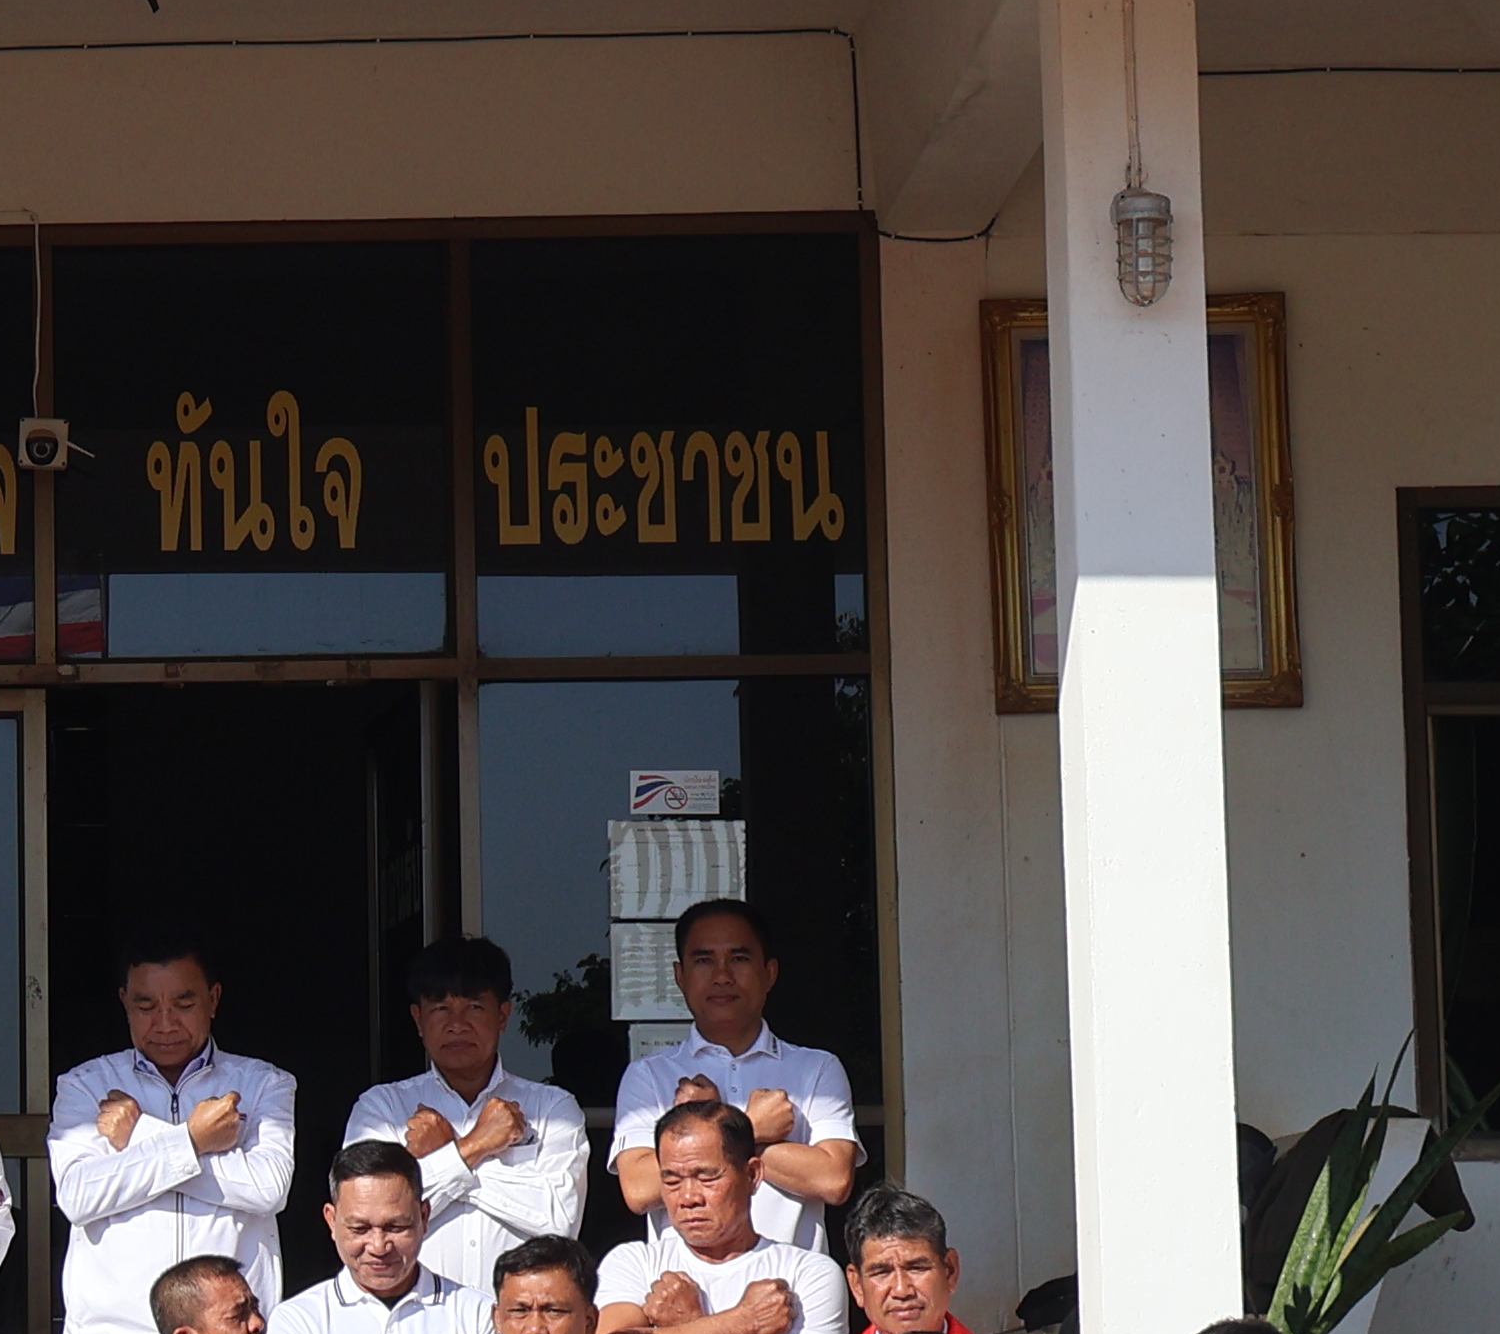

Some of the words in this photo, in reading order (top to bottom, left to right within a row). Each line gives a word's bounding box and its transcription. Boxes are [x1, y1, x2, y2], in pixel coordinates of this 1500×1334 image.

[146, 390, 363, 552] ทันใจ
[484, 405, 846, 545] ประชาชน
